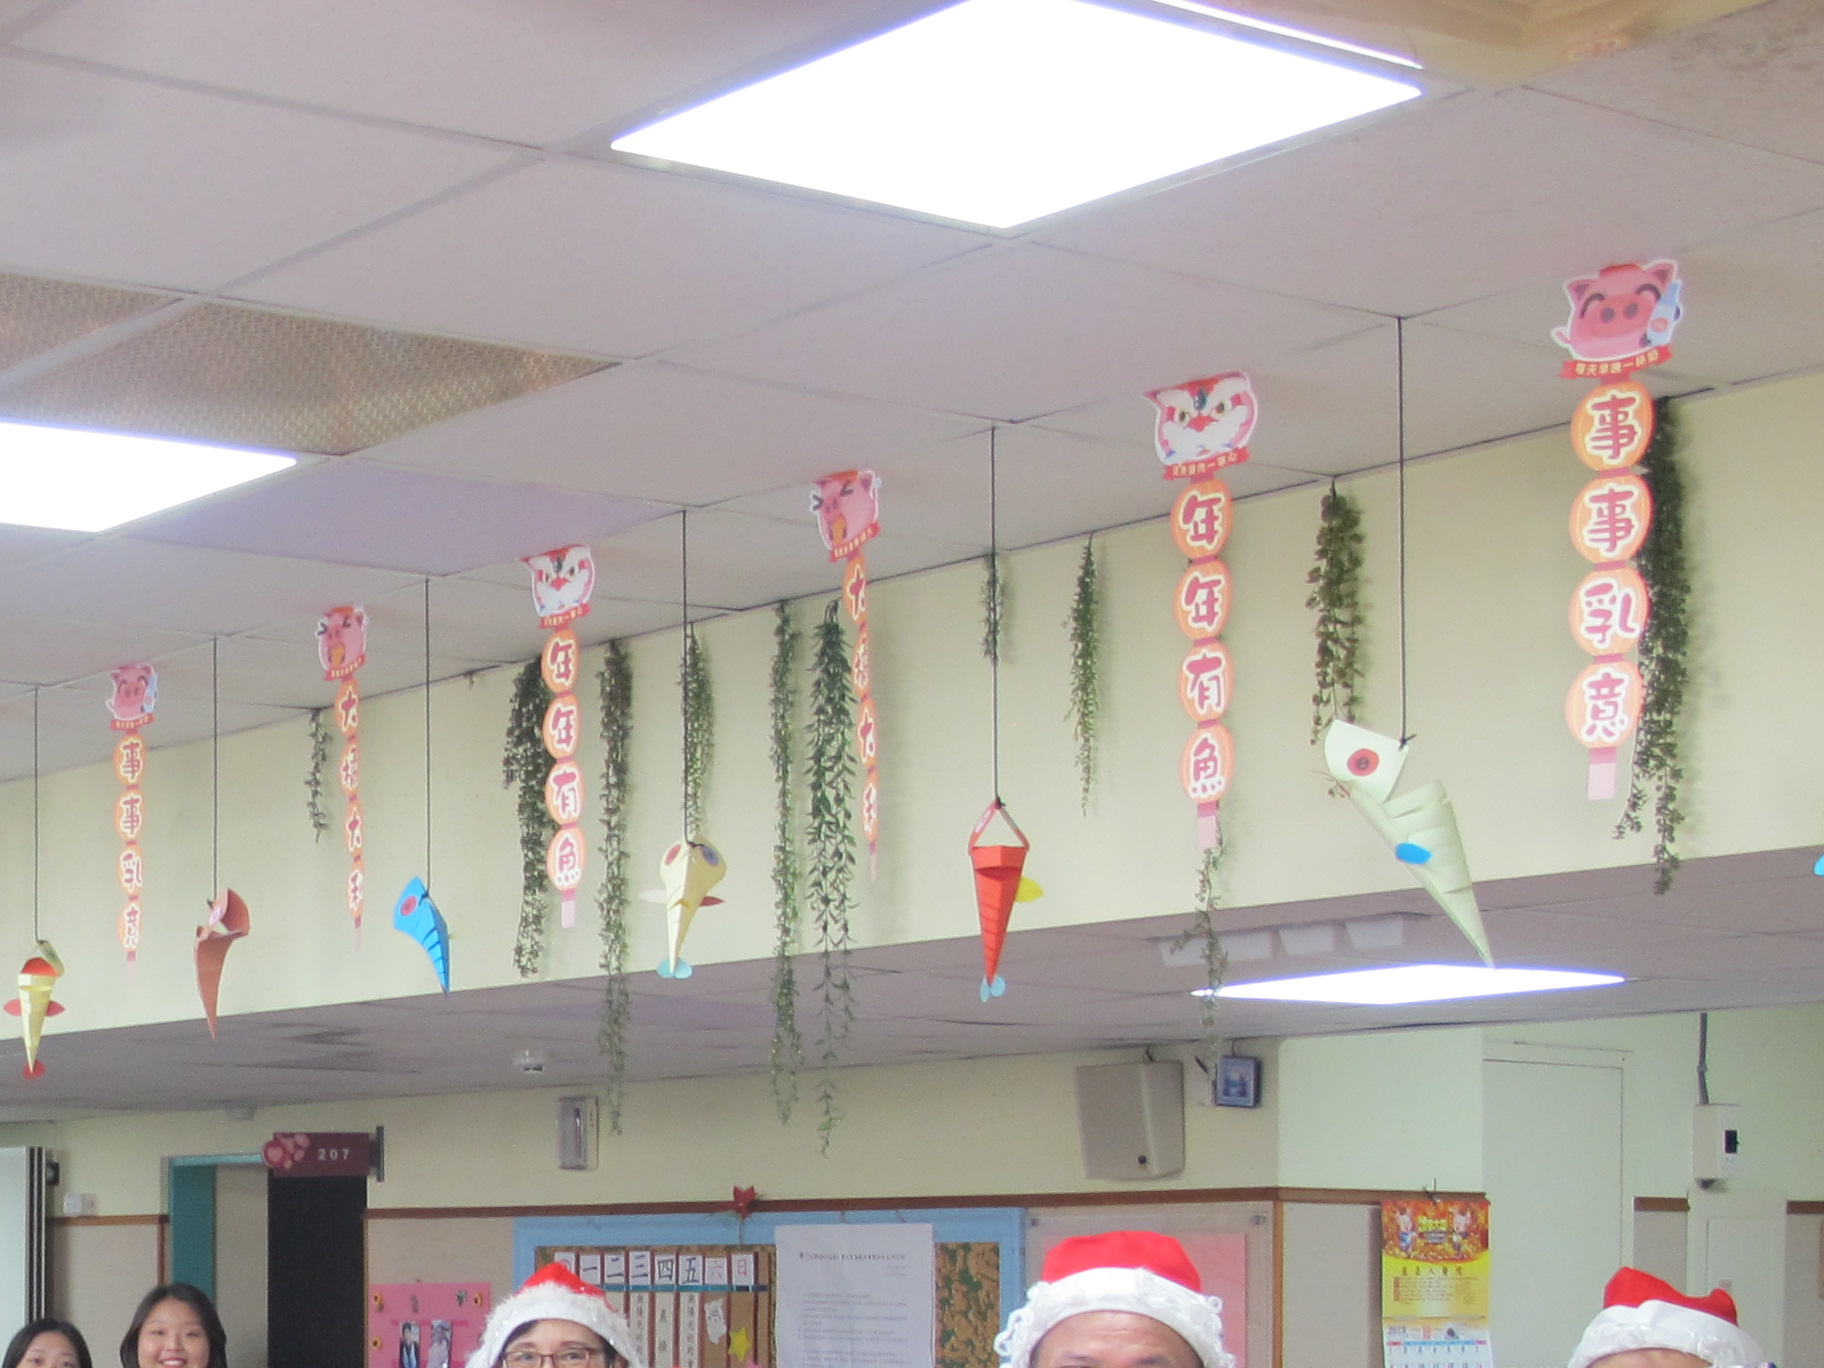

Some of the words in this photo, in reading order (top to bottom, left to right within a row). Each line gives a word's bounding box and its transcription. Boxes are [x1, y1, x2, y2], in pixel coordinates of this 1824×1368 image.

[1583, 392, 1638, 737] 事事乳意
[1181, 493, 1224, 795] 年年有魚
[549, 640, 580, 885] 年年有魚
[317, 1147, 351, 1161] 207
[607, 1256, 623, 1279] 二
[631, 1253, 649, 1279] 三
[657, 1257, 675, 1281] 四
[682, 1255, 700, 1285] 五
[709, 1259, 724, 1277] 六
